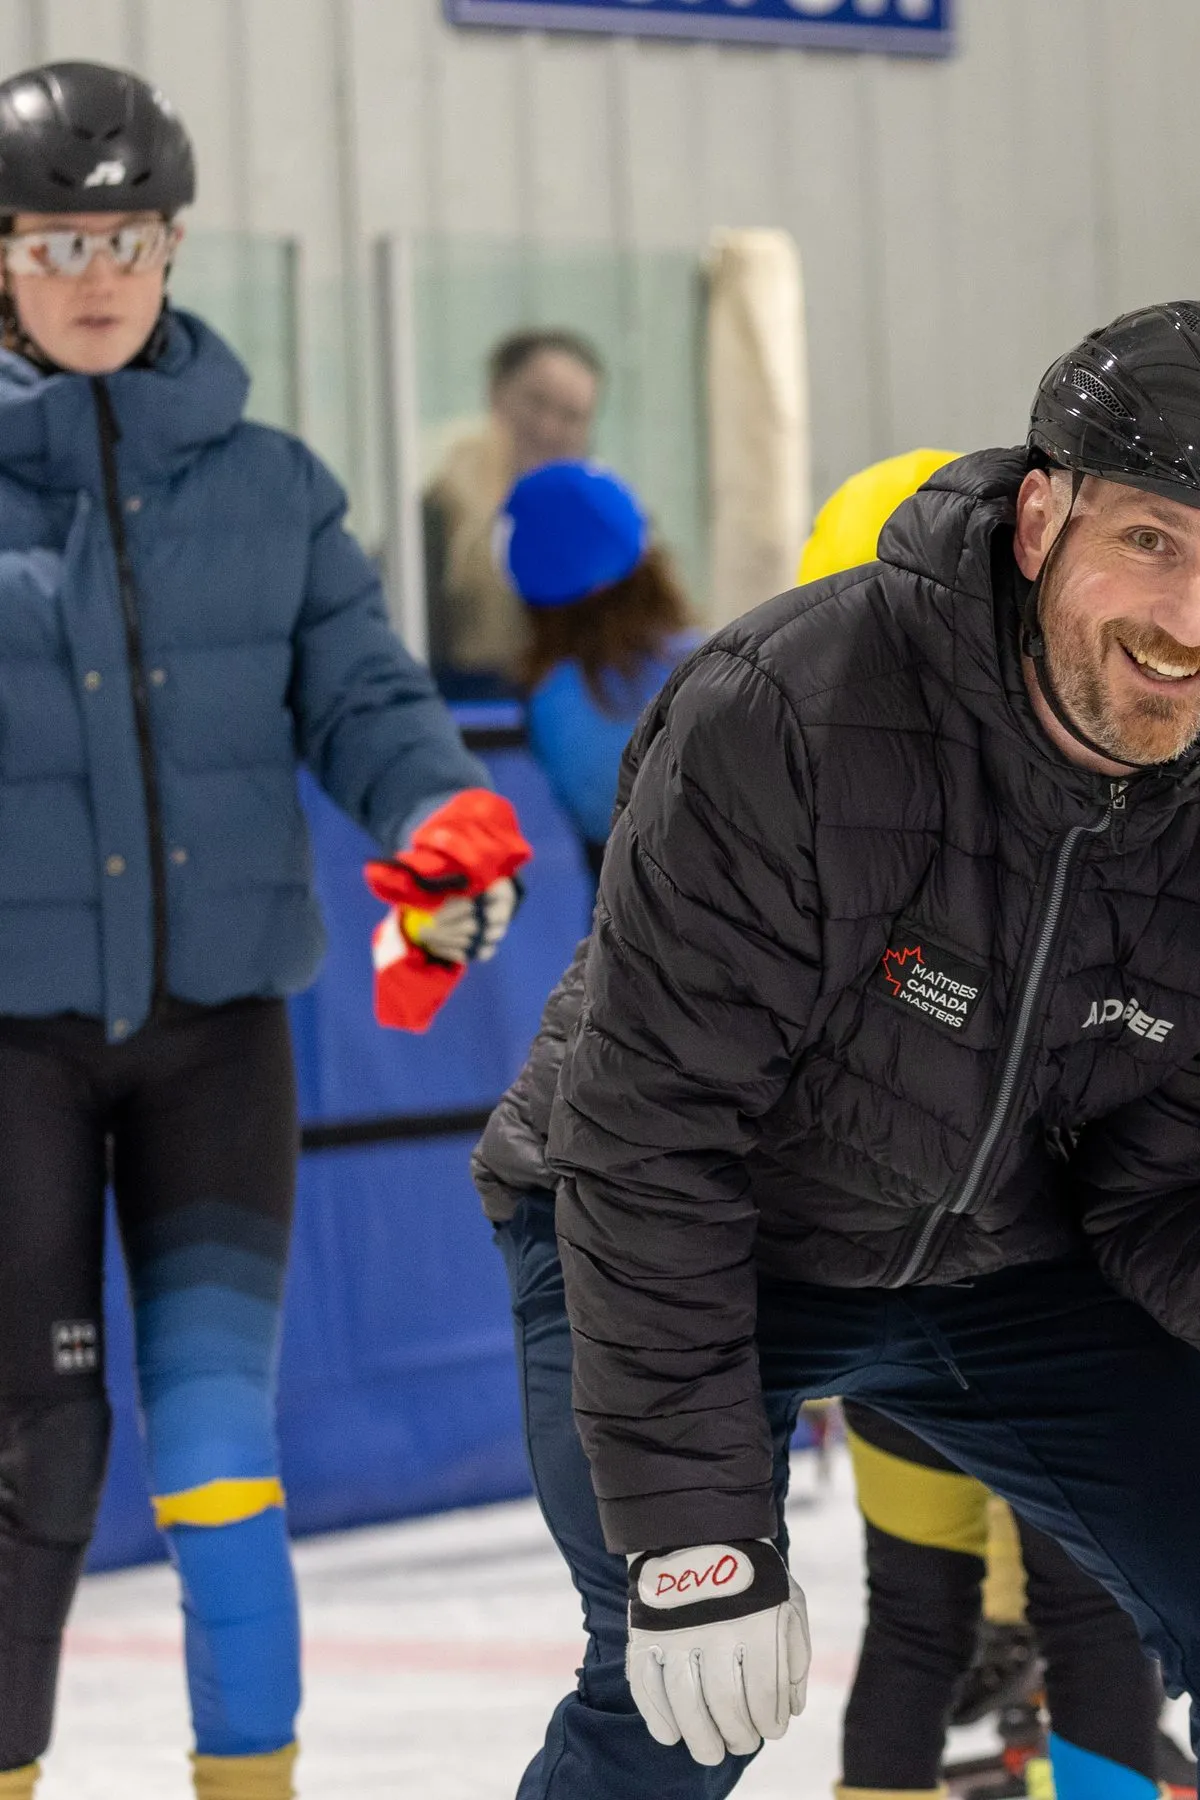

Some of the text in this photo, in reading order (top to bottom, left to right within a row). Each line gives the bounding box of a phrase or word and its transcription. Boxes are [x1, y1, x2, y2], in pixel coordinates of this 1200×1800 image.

[906, 979, 968, 1015] CANADA
[911, 963, 979, 1000] MAÎTRES
[899, 990, 964, 1028] MASTERS
